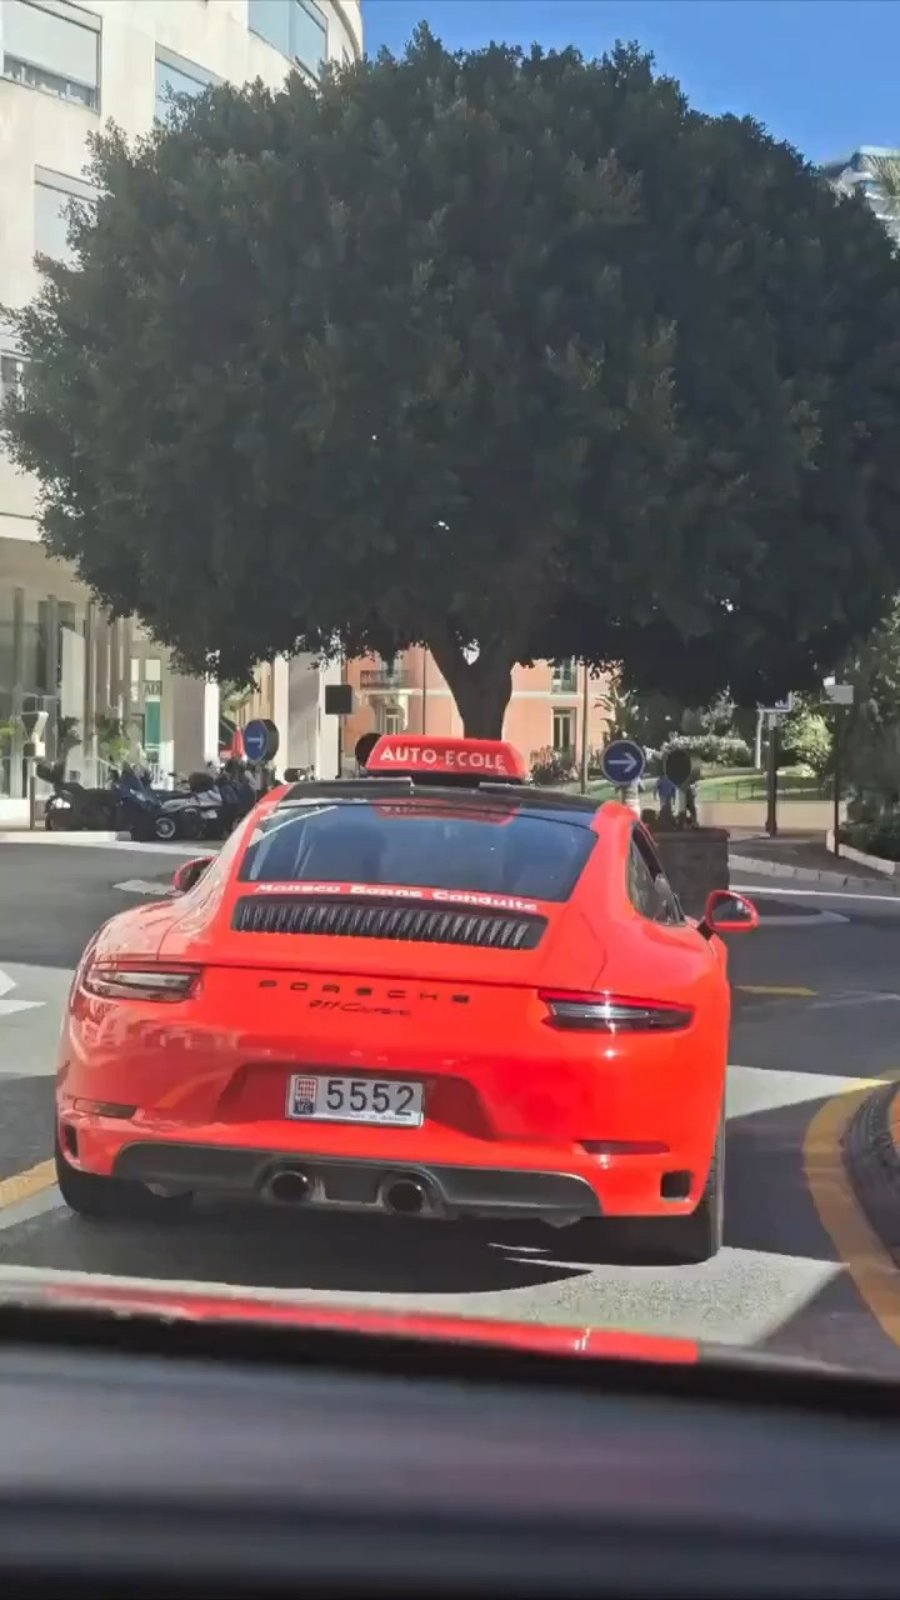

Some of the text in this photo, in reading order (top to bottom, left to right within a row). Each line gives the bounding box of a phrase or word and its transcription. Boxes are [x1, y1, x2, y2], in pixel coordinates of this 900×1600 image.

[380, 746, 506, 769] AUTO-ECOLE
[259, 979, 470, 1004] PORSCHE
[326, 1080, 415, 1116] 5552
